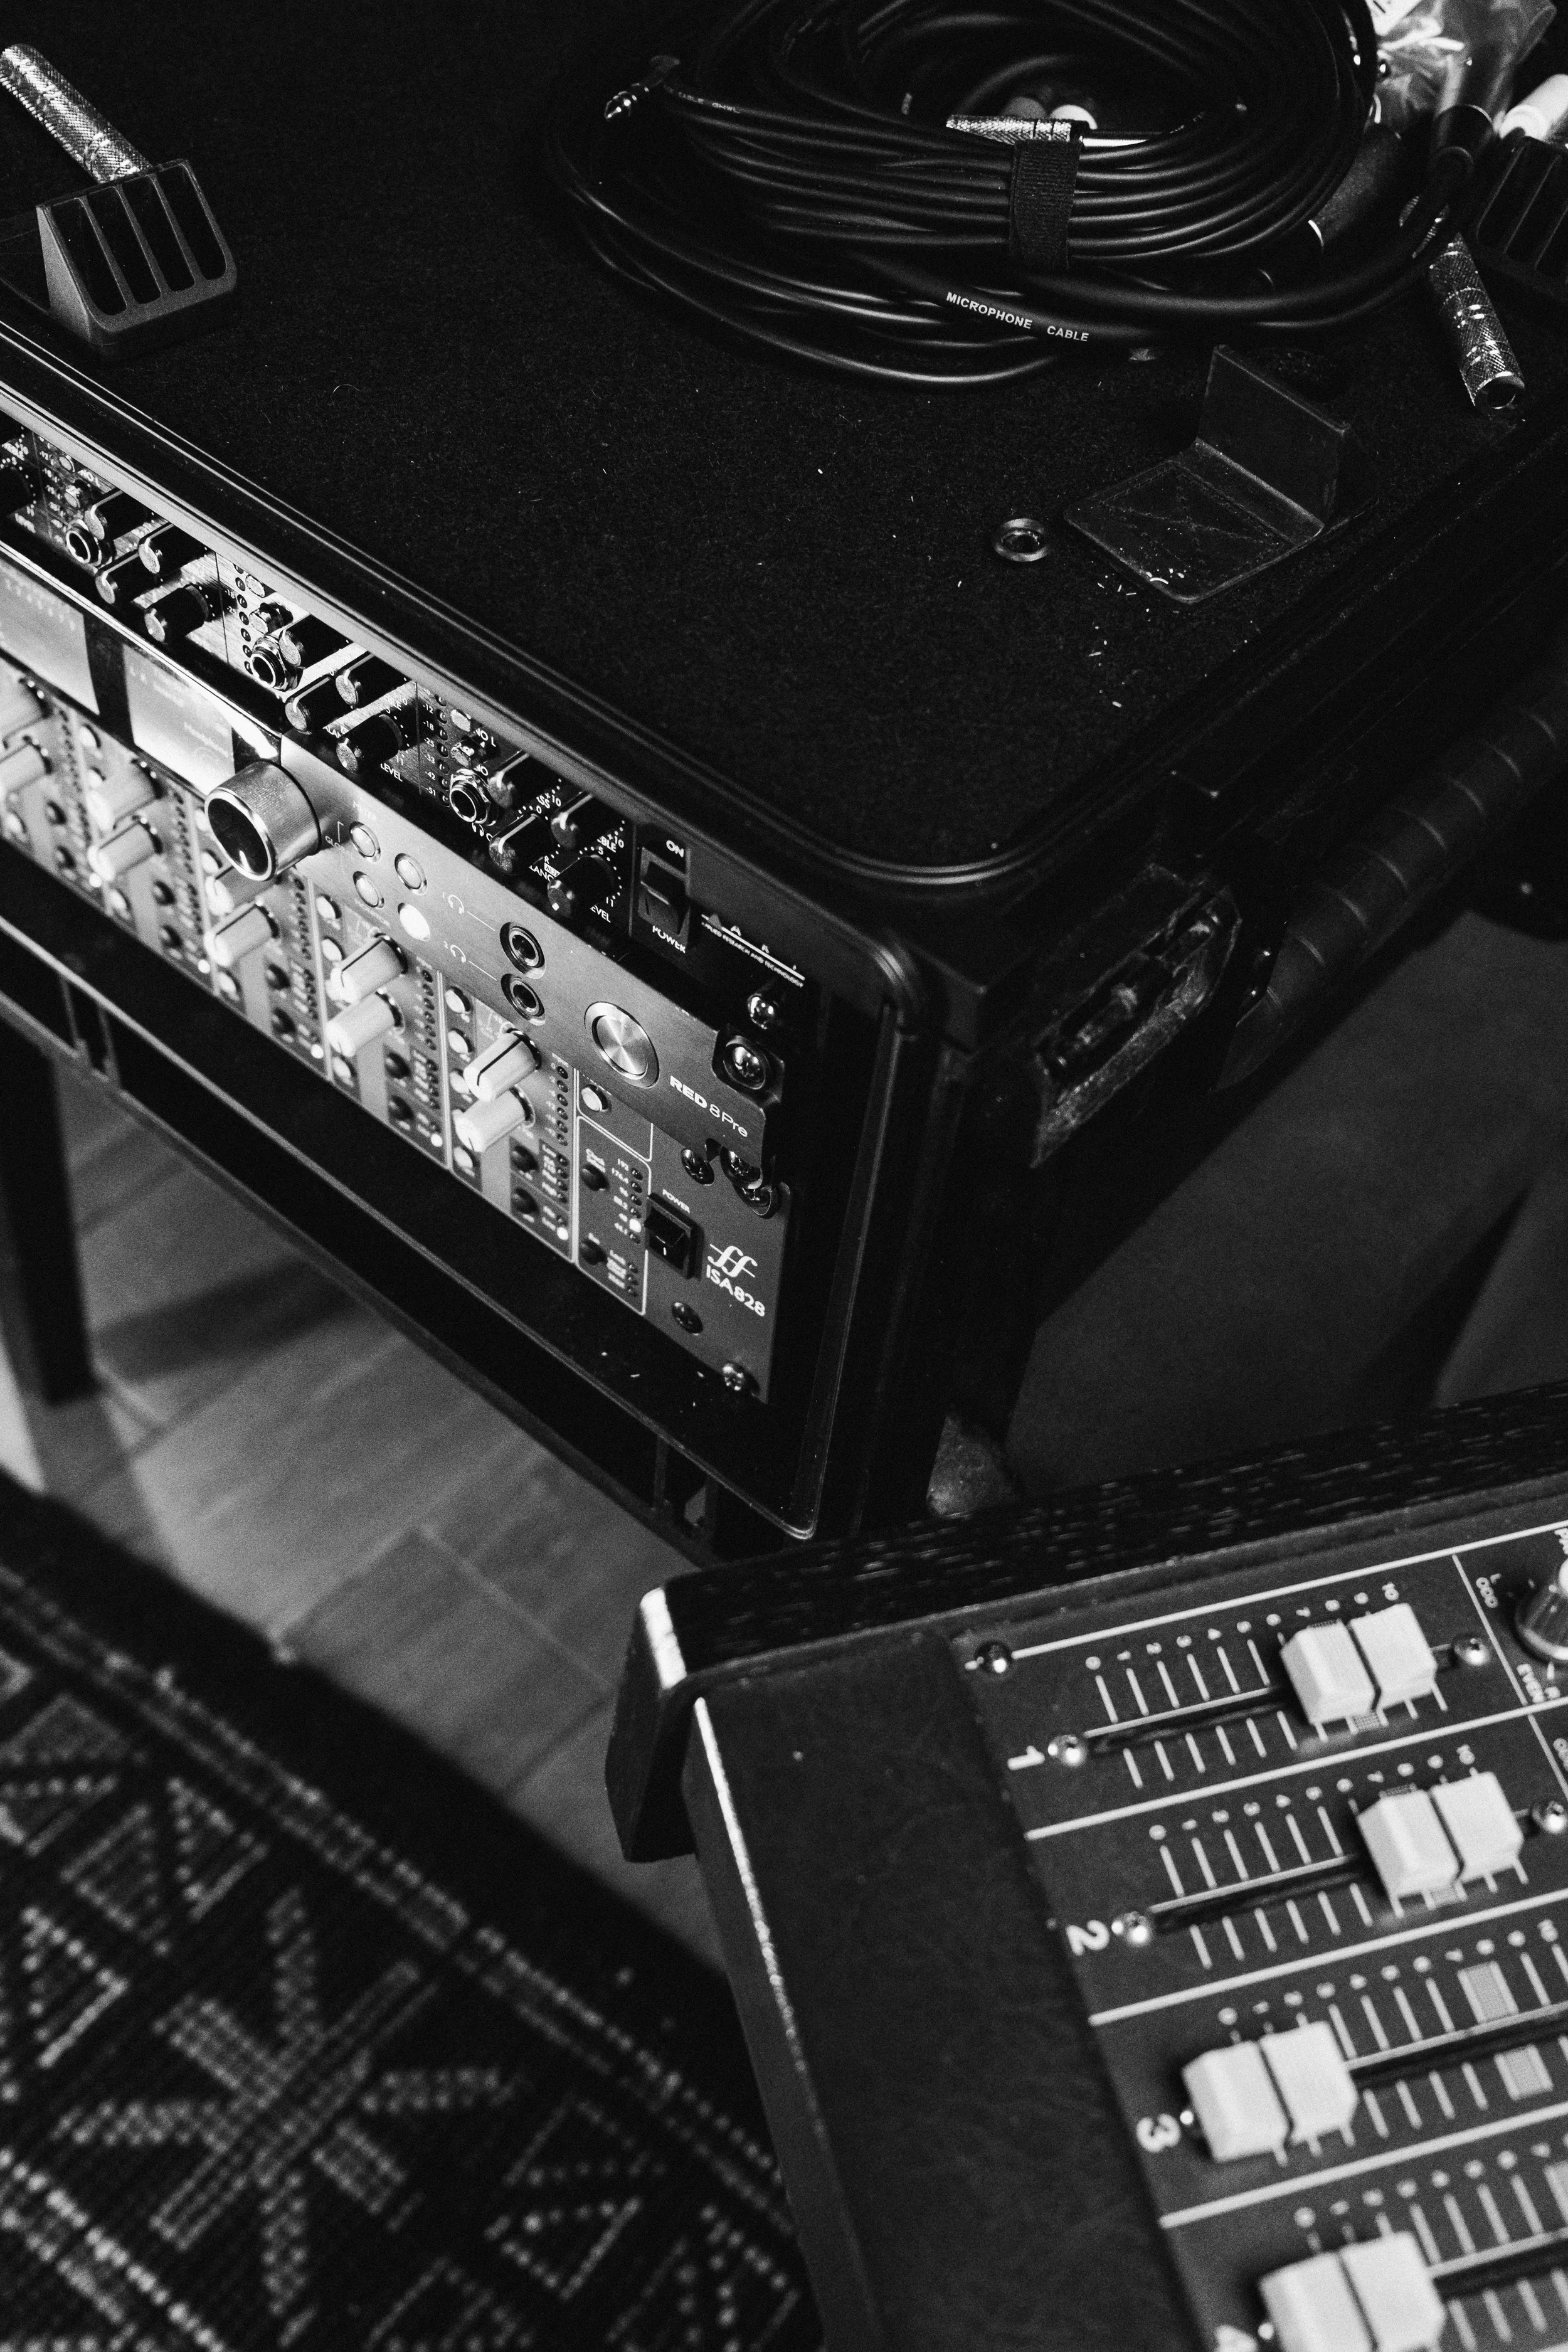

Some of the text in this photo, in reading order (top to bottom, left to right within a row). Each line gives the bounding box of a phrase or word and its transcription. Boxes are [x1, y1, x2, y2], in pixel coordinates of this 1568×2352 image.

[946, 292, 1089, 342] MICROPHONE CABLE
[423, 703, 434, 714] -12
[423, 721, 435, 731] -18
[424, 737, 435, 748] -25
[424, 754, 435, 764] -33
[380, 763, 403, 782] LEVEL
[425, 771, 436, 781] -42
[426, 787, 437, 797] -51
[666, 840, 684, 857] ON
[544, 855, 550, 864] R
[590, 904, 612, 923] EVEL
[670, 1075, 748, 1137] RED 8Pre
[662, 1189, 691, 1214] POWER
[706, 1264, 765, 1316] ISA828
[1475, 1577, 1498, 1609] ODD
[1007, 1745, 1046, 1771] 1
[1066, 1920, 1110, 1956] 2
[1136, 2113, 1181, 2153] 3
